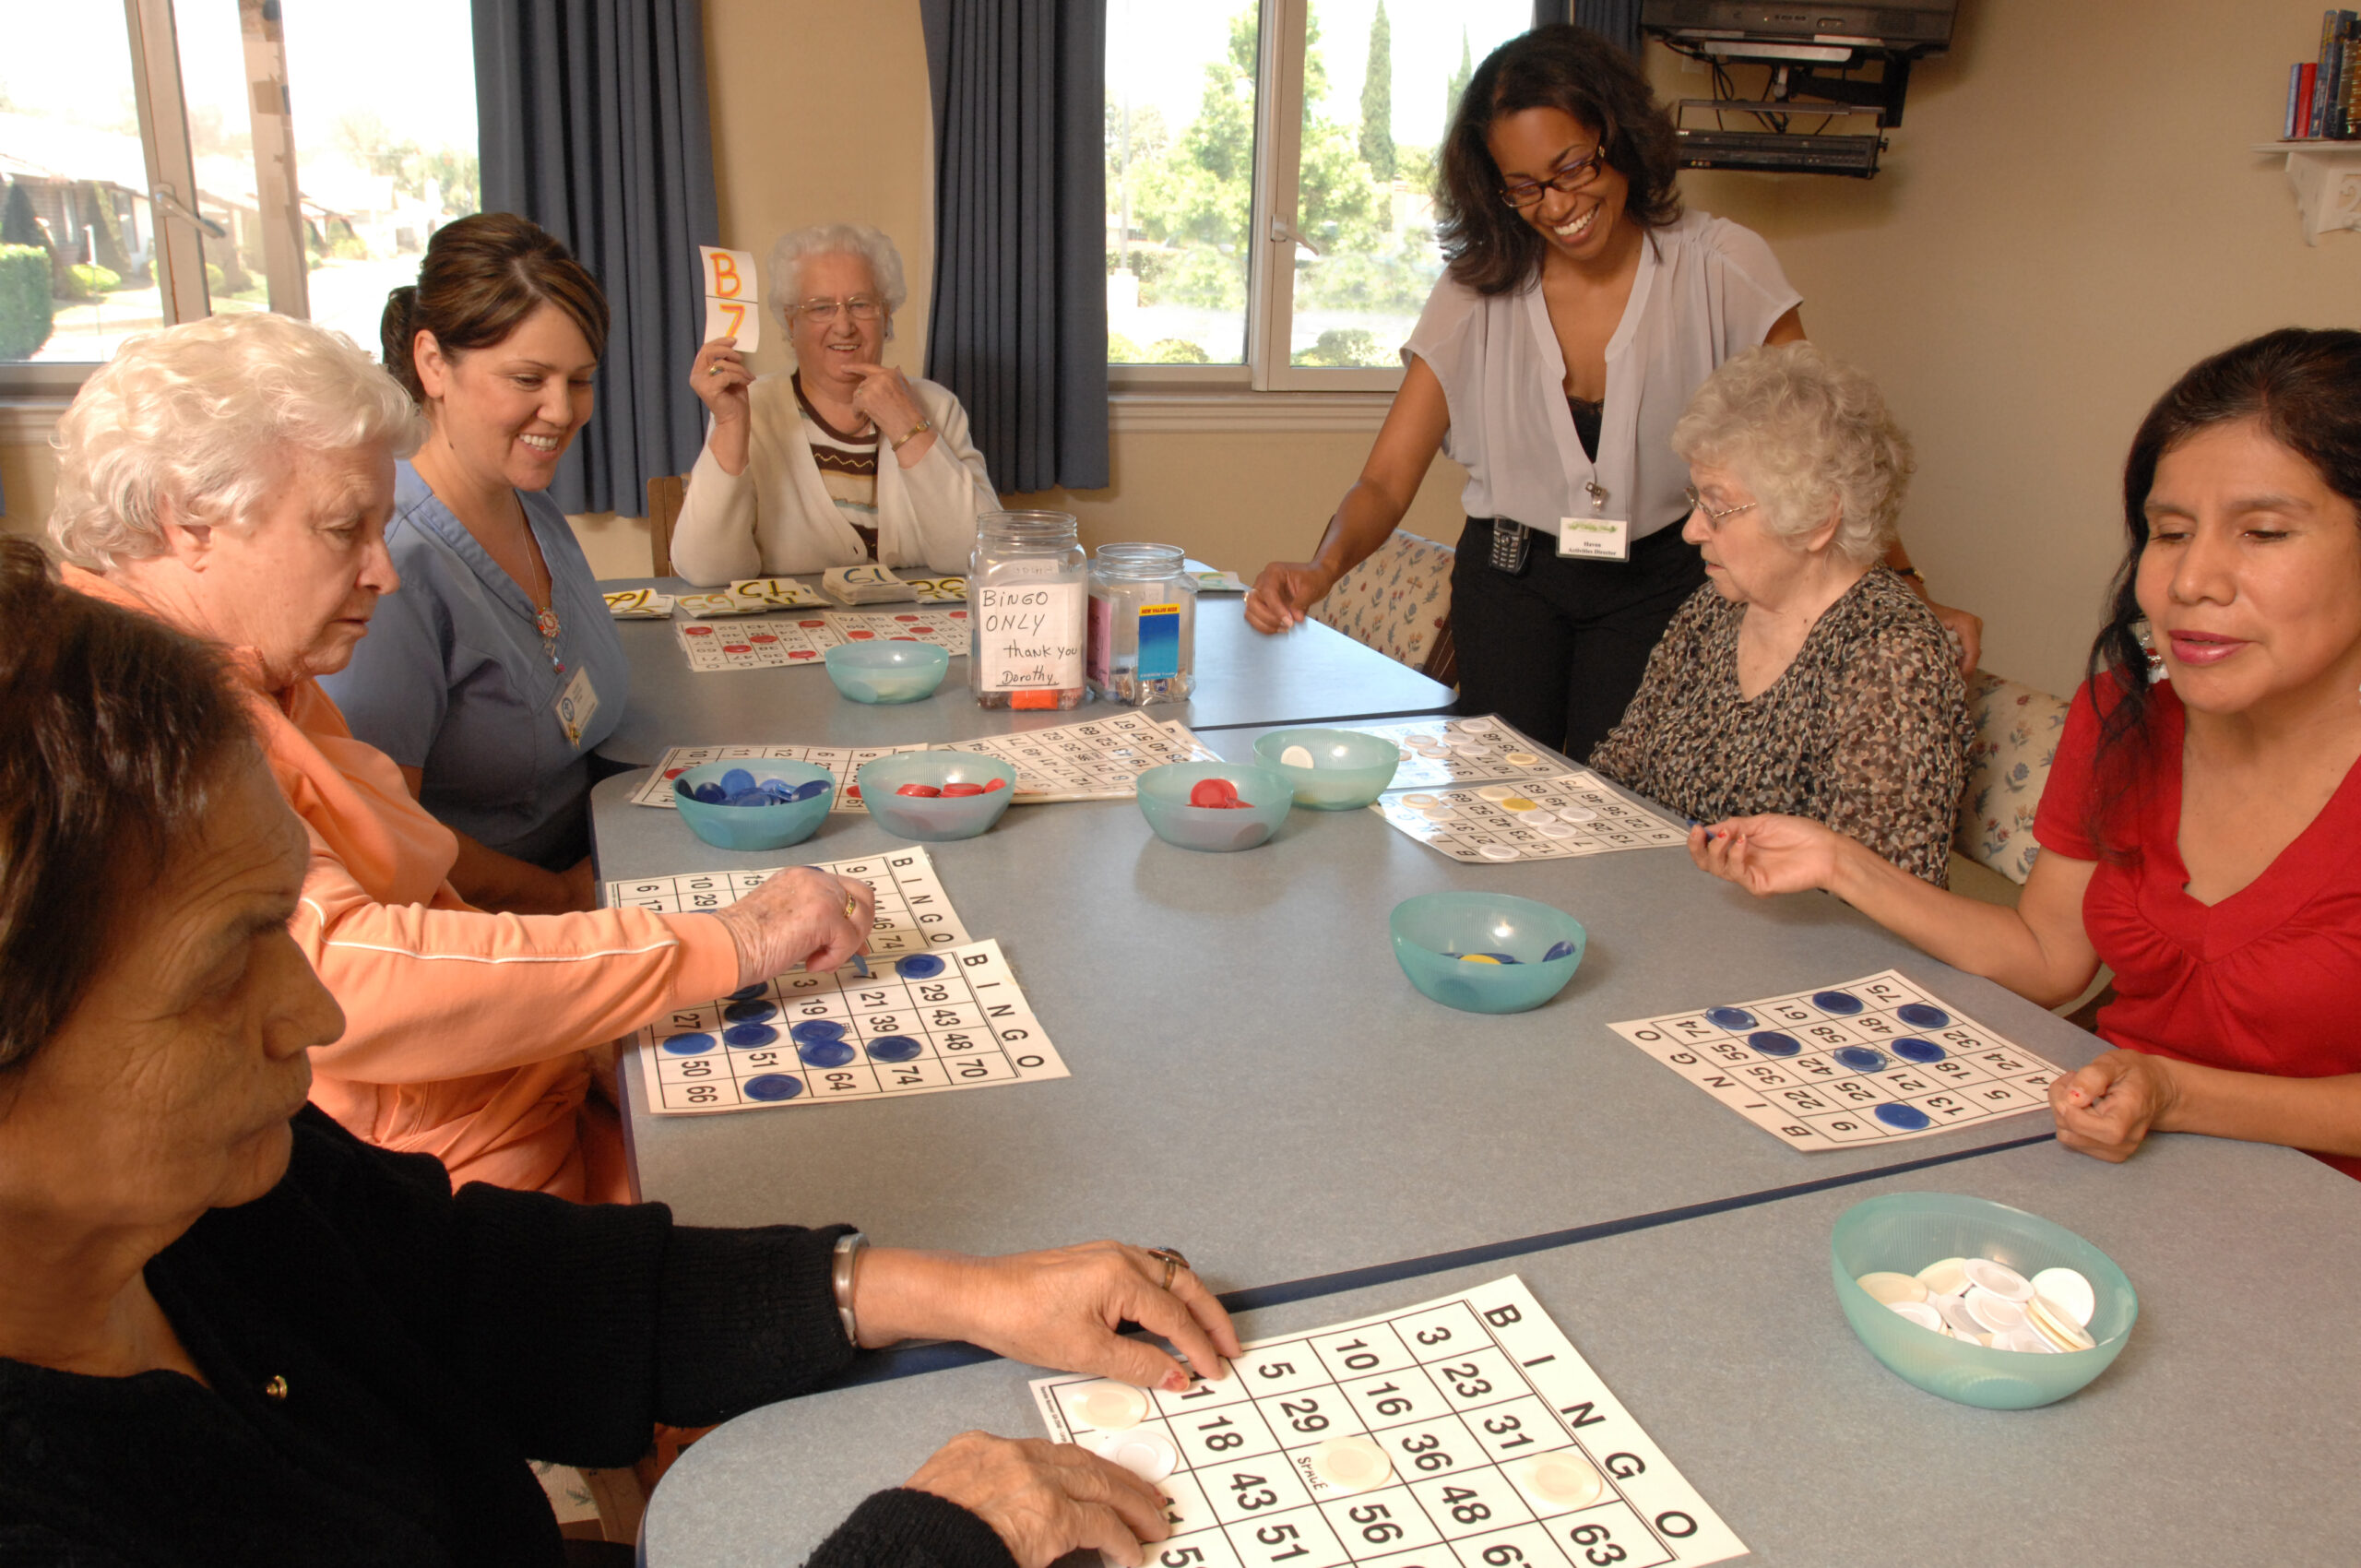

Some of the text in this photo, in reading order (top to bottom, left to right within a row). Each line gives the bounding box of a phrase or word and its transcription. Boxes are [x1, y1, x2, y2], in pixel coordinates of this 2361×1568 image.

[709, 252, 742, 298] B
[719, 303, 744, 338] 7
[737, 579, 797, 600] 45
[986, 613, 1046, 636] ONLY
[1058, 645, 1078, 659] you
[1078, 726, 1099, 735] 69
[1113, 720, 1136, 731] 67
[1042, 731, 1063, 741] 62
[1095, 737, 1118, 747] 52
[1130, 732, 1155, 742] 57
[1022, 748, 1043, 757] 49
[1060, 742, 1082, 752] 55
[1148, 742, 1170, 753] 40
[1053, 768, 1075, 777] 17
[1092, 764, 1115, 773] 21
[1523, 783, 1547, 794] 63
[1580, 793, 1605, 804] 46
[1601, 805, 1622, 816] 36
[1449, 793, 1556, 854] 12 23 42 52 69
[1586, 821, 1612, 832] 28
[1624, 817, 1652, 829] 22
[1469, 834, 1496, 845] 27
[1609, 834, 1634, 845] 13
[892, 857, 914, 867] B
[690, 876, 718, 907] 10 29
[846, 865, 868, 873] 9
[878, 935, 905, 949] 74
[908, 895, 933, 905] N
[919, 913, 943, 923] G
[931, 932, 954, 943] O
[860, 992, 888, 1008] 21
[1865, 984, 1902, 1003] 75
[963, 954, 989, 967] B
[987, 1004, 1015, 1017] N
[1001, 1028, 1029, 1041] G
[1016, 1055, 1045, 1068] O
[870, 1016, 899, 1033] 39
[919, 984, 988, 1078] 29 43 48 70
[793, 979, 856, 1091] 3 19 64
[1635, 1030, 1661, 1041] O
[1942, 1030, 1982, 1049] 32
[672, 1014, 718, 1103] 27 50 66
[749, 1052, 779, 1068] 51
[1669, 1052, 1698, 1065] G
[1774, 1005, 1965, 1116] 13 21 58 61
[1858, 1017, 2011, 1099] 5 18 48
[1983, 1052, 2024, 1071] 24
[891, 1065, 923, 1086] 74
[1676, 1020, 1858, 1131] 9 22 35 55 74
[1703, 1076, 1736, 1088] N
[1797, 1057, 1877, 1101] 25 42
[2024, 1075, 2050, 1092] 4
[1781, 1125, 1813, 1137] B
[1483, 1303, 1698, 1538] B I N G O
[1258, 1361, 1297, 1380] 5
[1280, 1398, 1330, 1433] 29
[1348, 1503, 1404, 1544] 56
[1335, 1338, 1536, 1568] 10 16 36 48 6
[1416, 1326, 1627, 1567] 3 23 31 63
[1197, 1415, 1244, 1452] 18
[1229, 1472, 1277, 1511] 43
[1256, 1524, 1310, 1562] 51
[1160, 1547, 1210, 1568] 5
